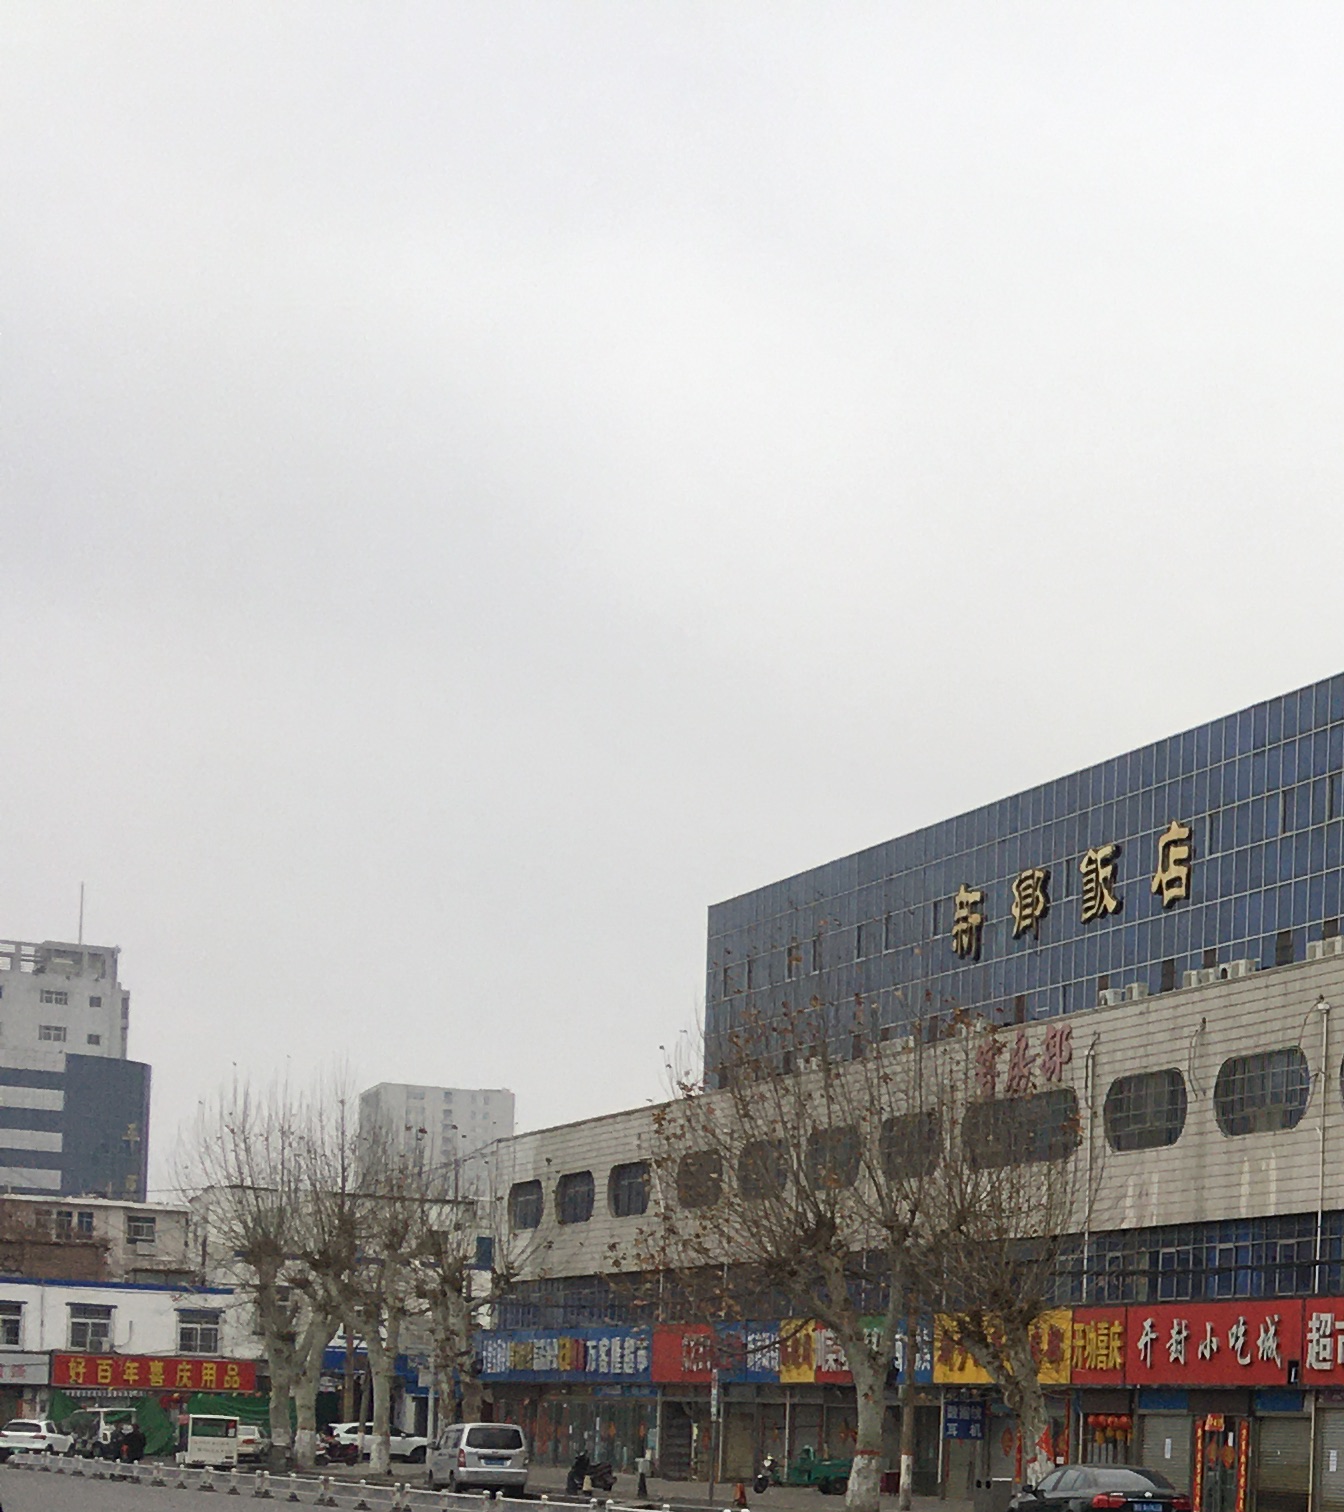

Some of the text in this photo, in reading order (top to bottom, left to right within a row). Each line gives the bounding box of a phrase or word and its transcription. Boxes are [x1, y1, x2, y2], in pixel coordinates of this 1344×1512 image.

[1137, 1314, 1284, 1369] 开封小吃城
[69, 1358, 241, 1388] 好百年喜庆用品
